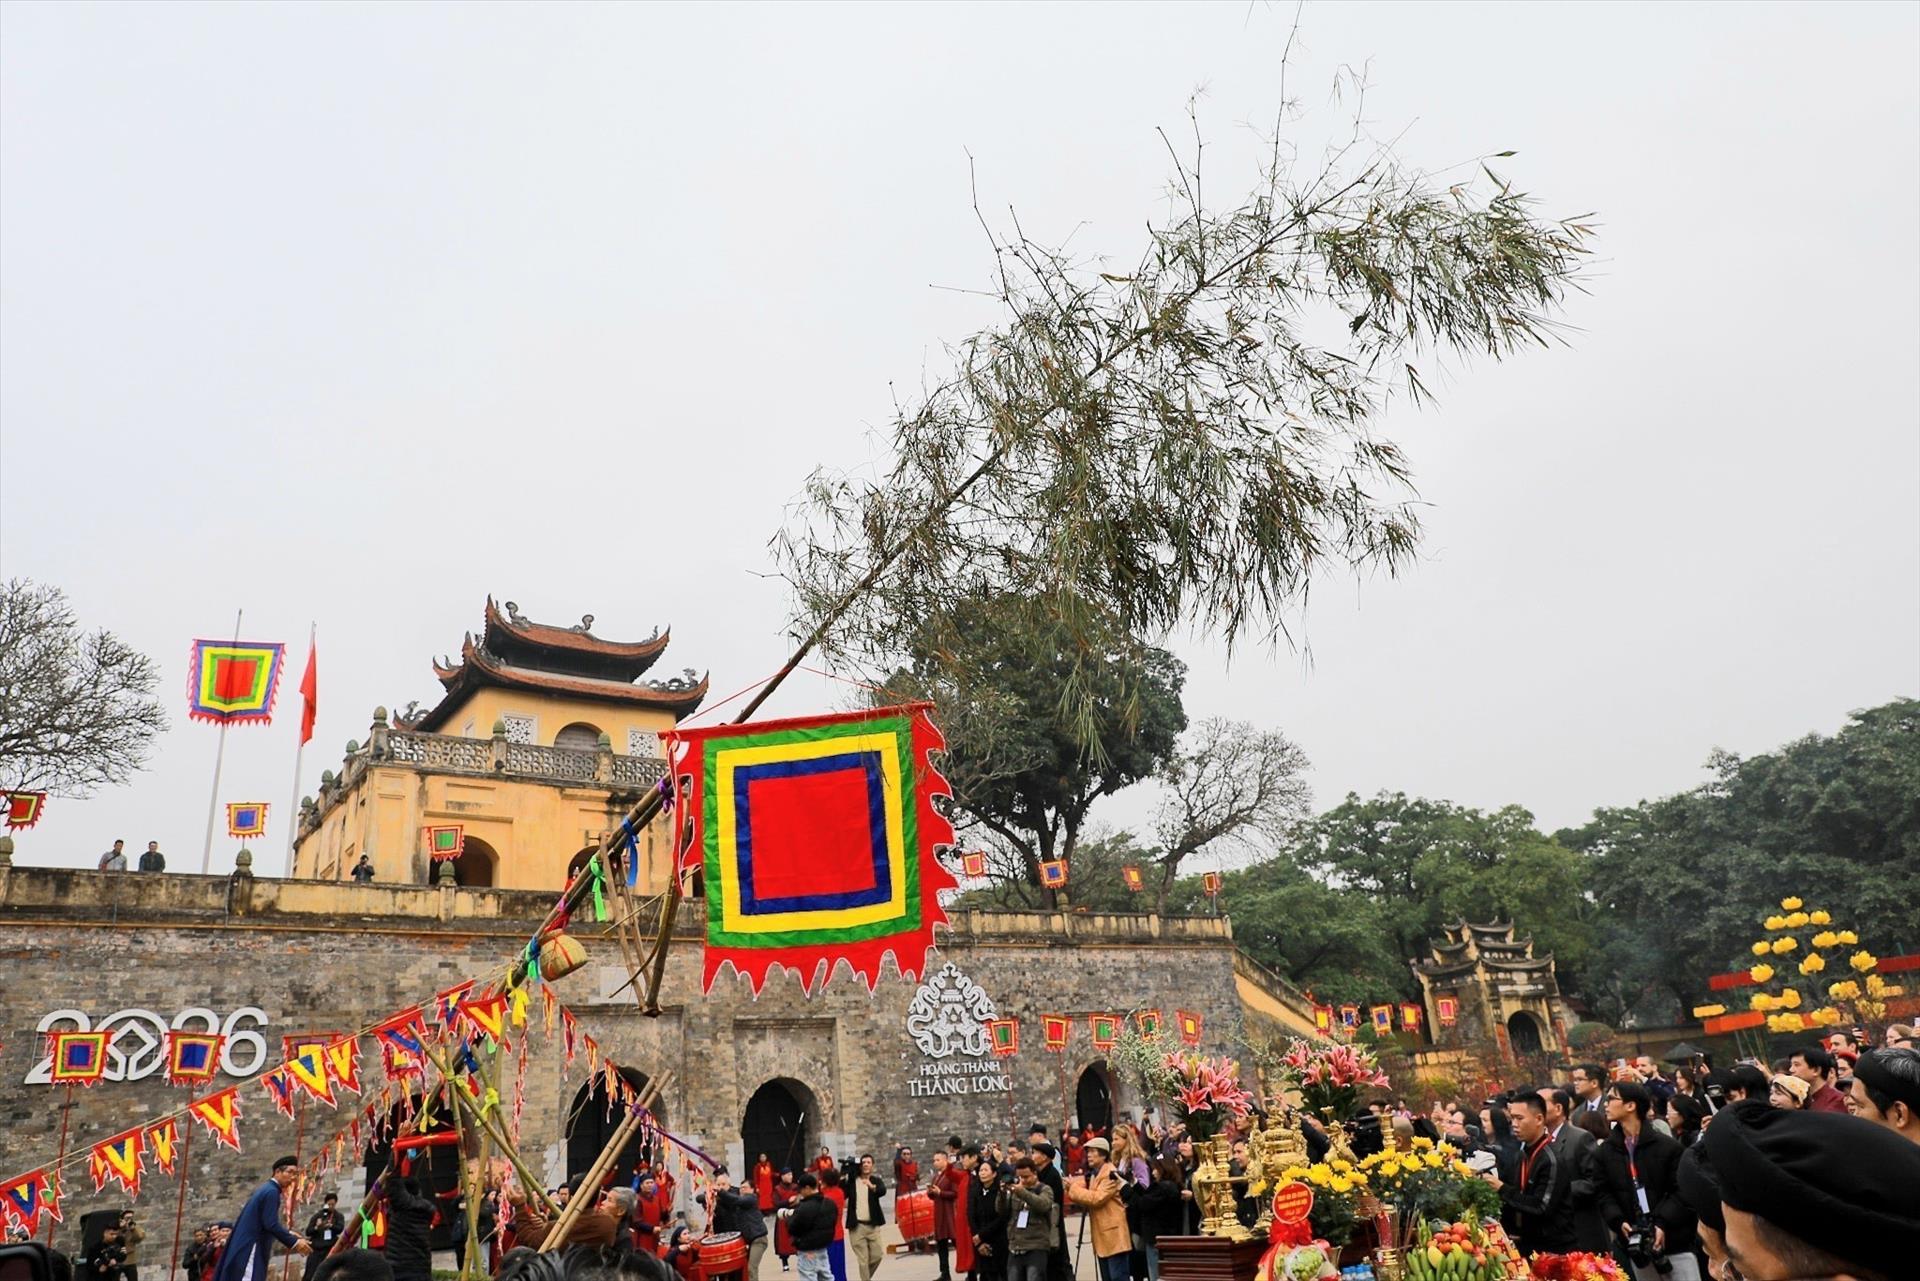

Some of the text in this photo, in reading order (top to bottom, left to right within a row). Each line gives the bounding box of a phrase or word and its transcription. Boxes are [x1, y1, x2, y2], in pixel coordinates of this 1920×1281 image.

[961, 1060, 1001, 1074] THÀNH
[907, 1075, 1013, 1096] THĂNG LONG
